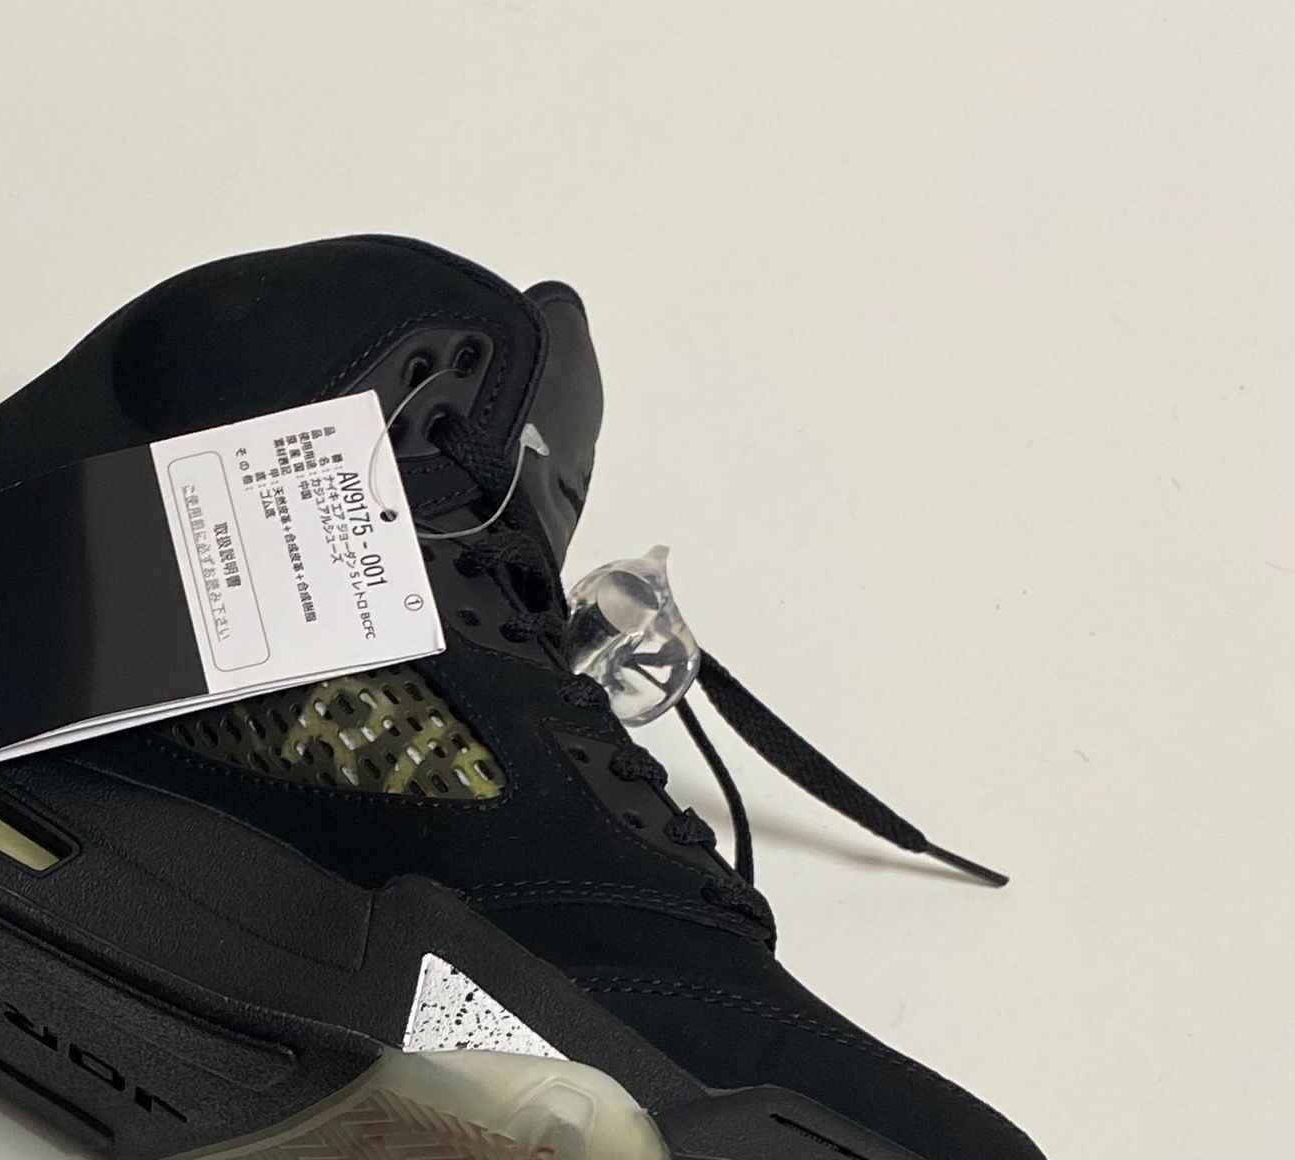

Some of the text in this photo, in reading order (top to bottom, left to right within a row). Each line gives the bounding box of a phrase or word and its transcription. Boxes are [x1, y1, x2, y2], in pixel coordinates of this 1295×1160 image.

[212, 521, 242, 589] 取扱説明書
